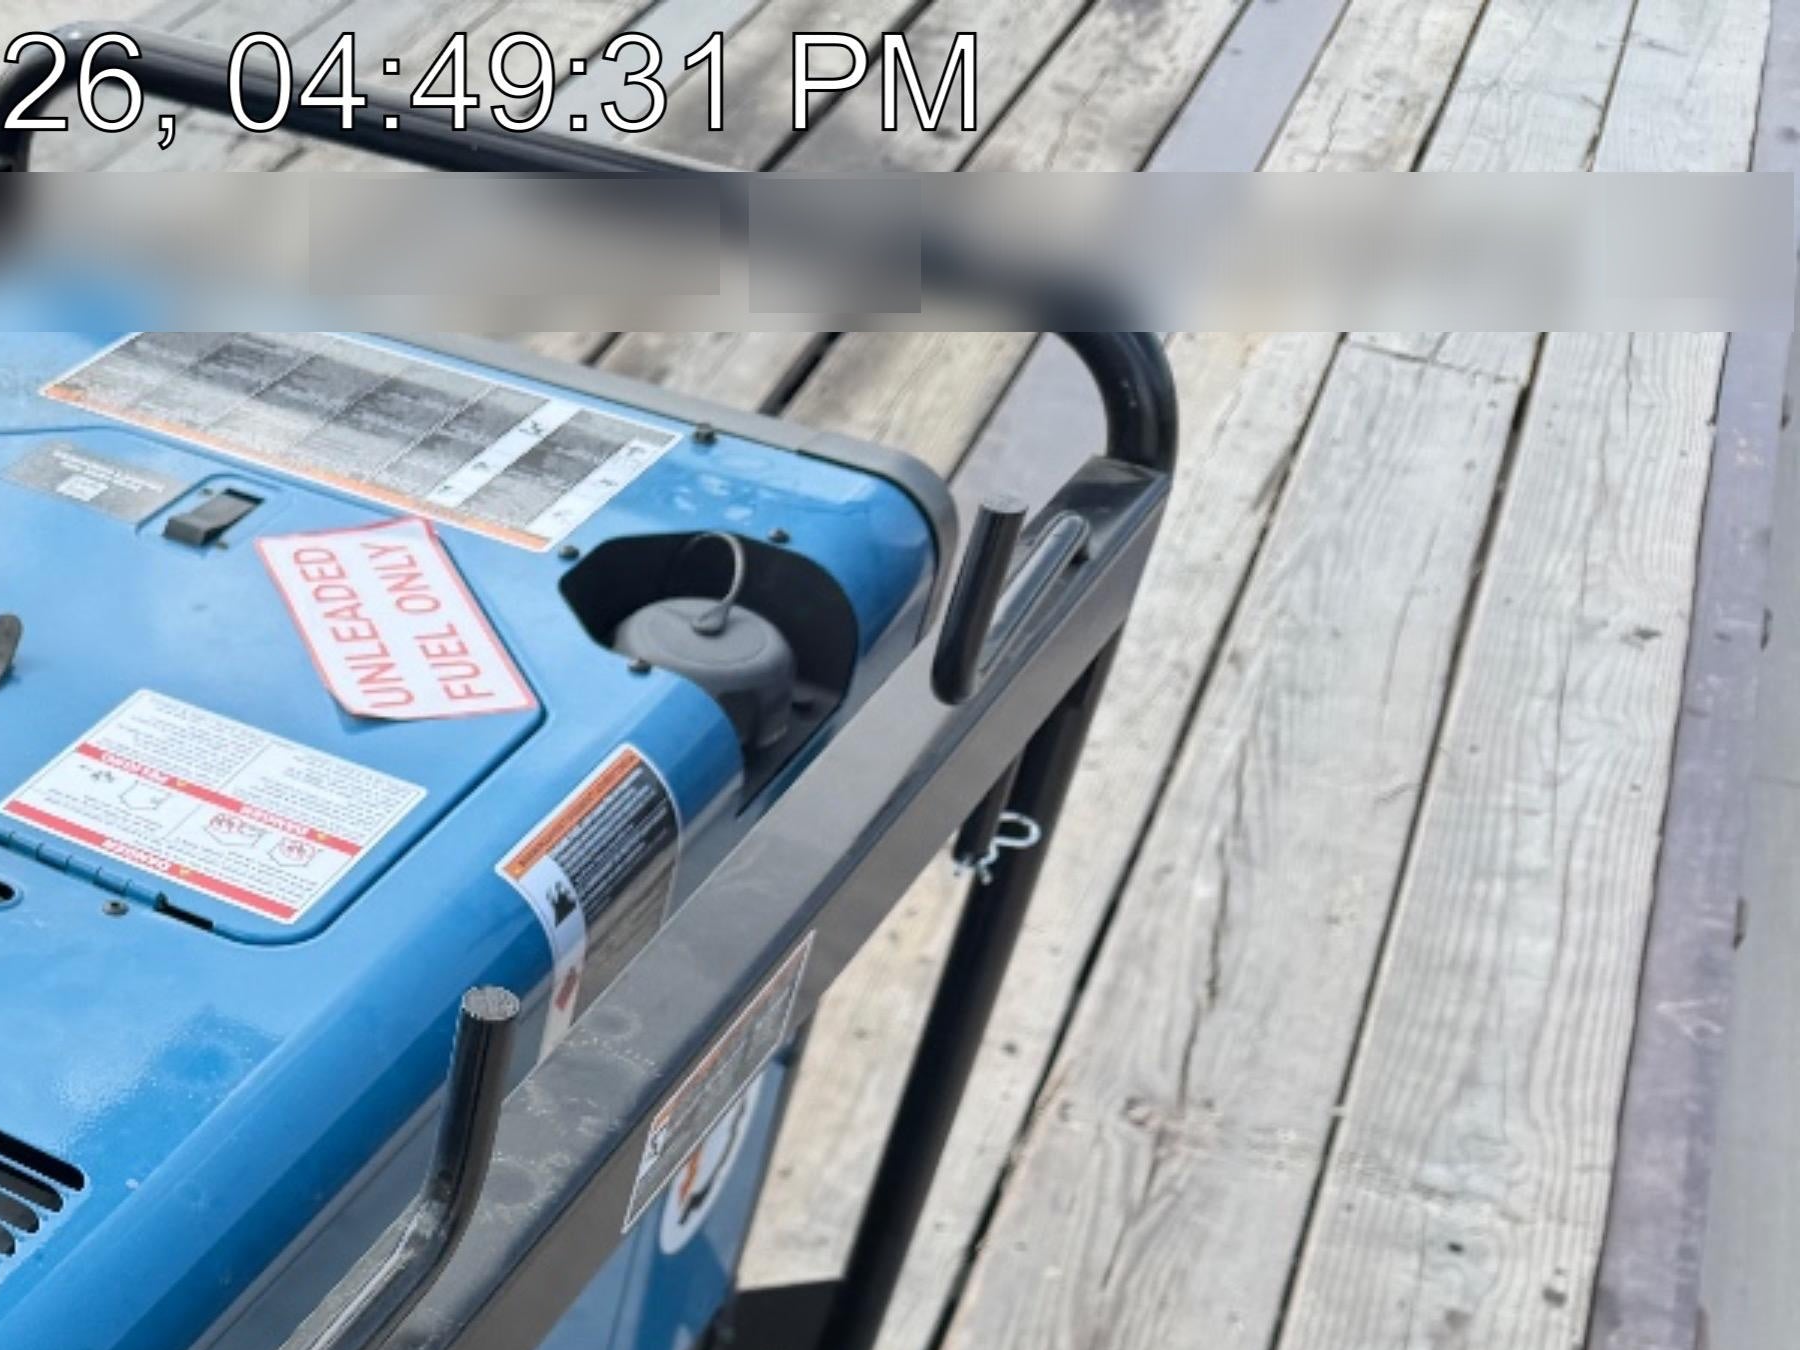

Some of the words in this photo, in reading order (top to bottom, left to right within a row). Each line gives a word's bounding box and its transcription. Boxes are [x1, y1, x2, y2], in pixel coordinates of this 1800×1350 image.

[360, 541, 441, 616] ONLY
[293, 548, 415, 708] UNLEADED
[413, 621, 494, 700] FUEL
